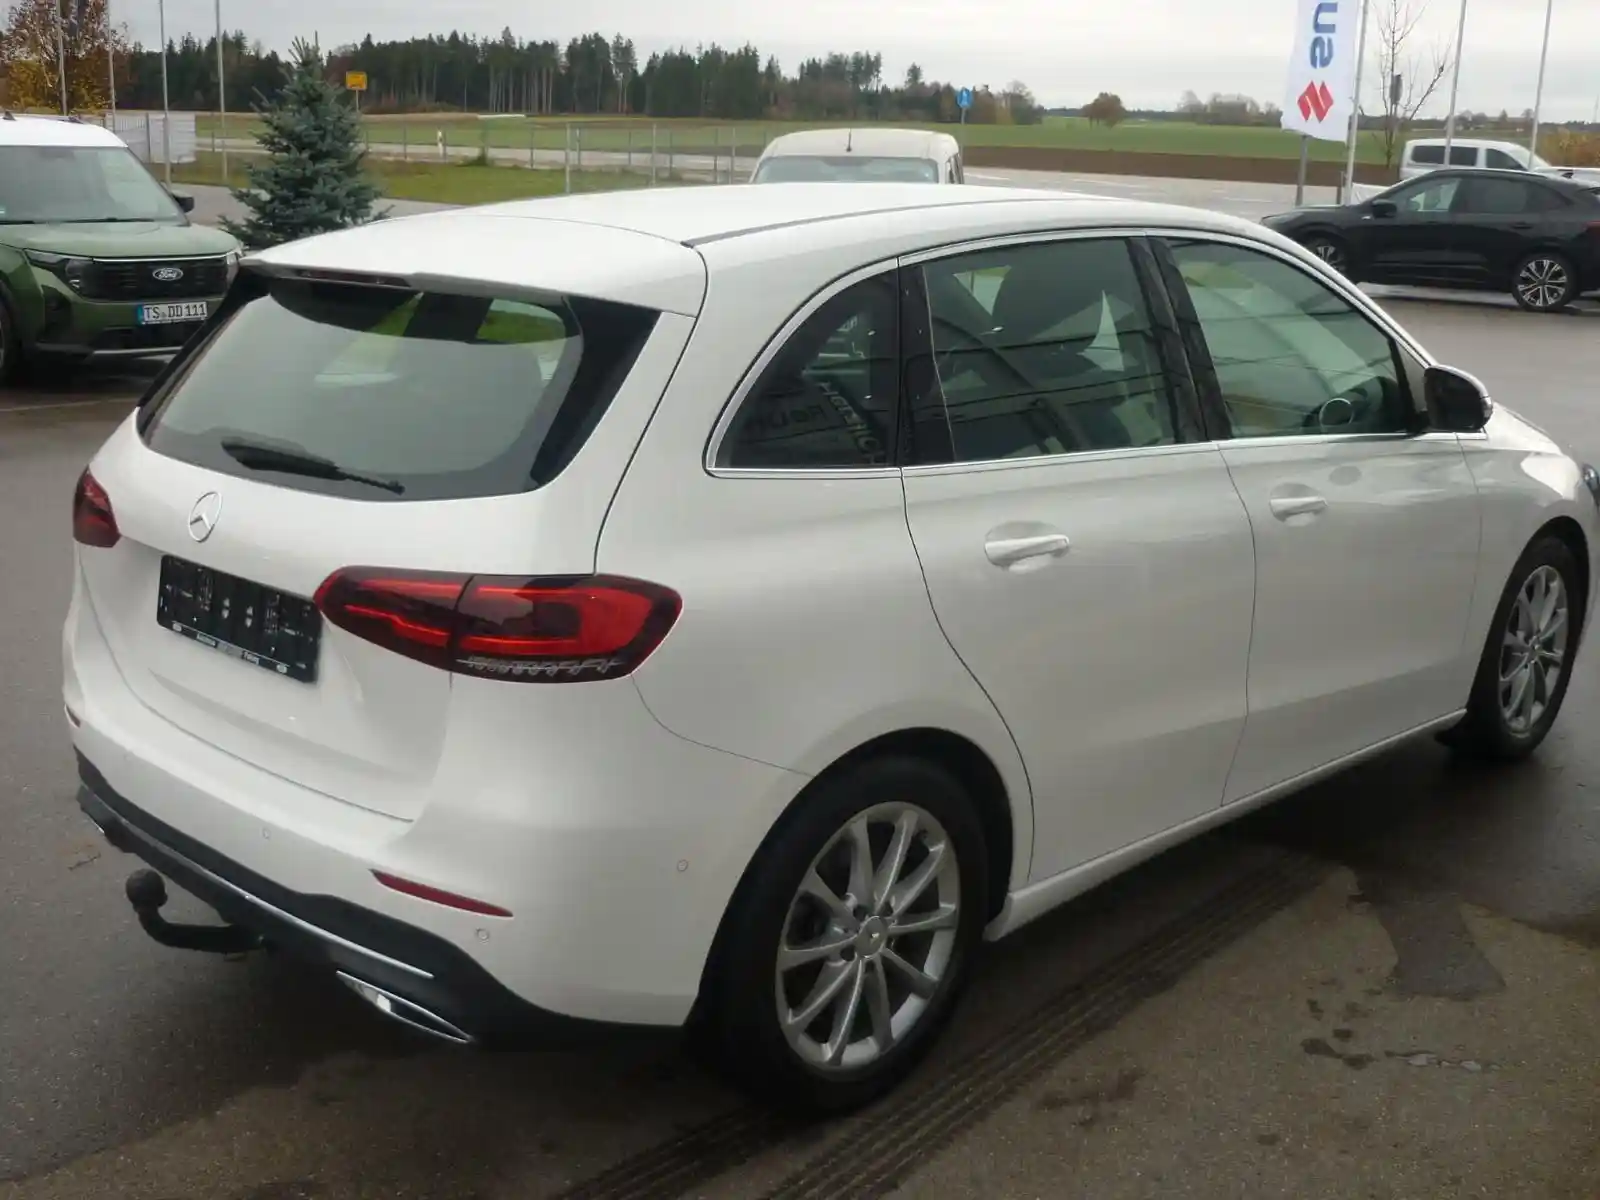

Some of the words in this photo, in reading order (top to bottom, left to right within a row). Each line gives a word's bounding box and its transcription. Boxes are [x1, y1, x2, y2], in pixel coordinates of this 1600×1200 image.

[155, 268, 181, 280] Ford
[143, 306, 160, 321] TS
[167, 304, 183, 318] DD
[184, 302, 206, 317] 111
